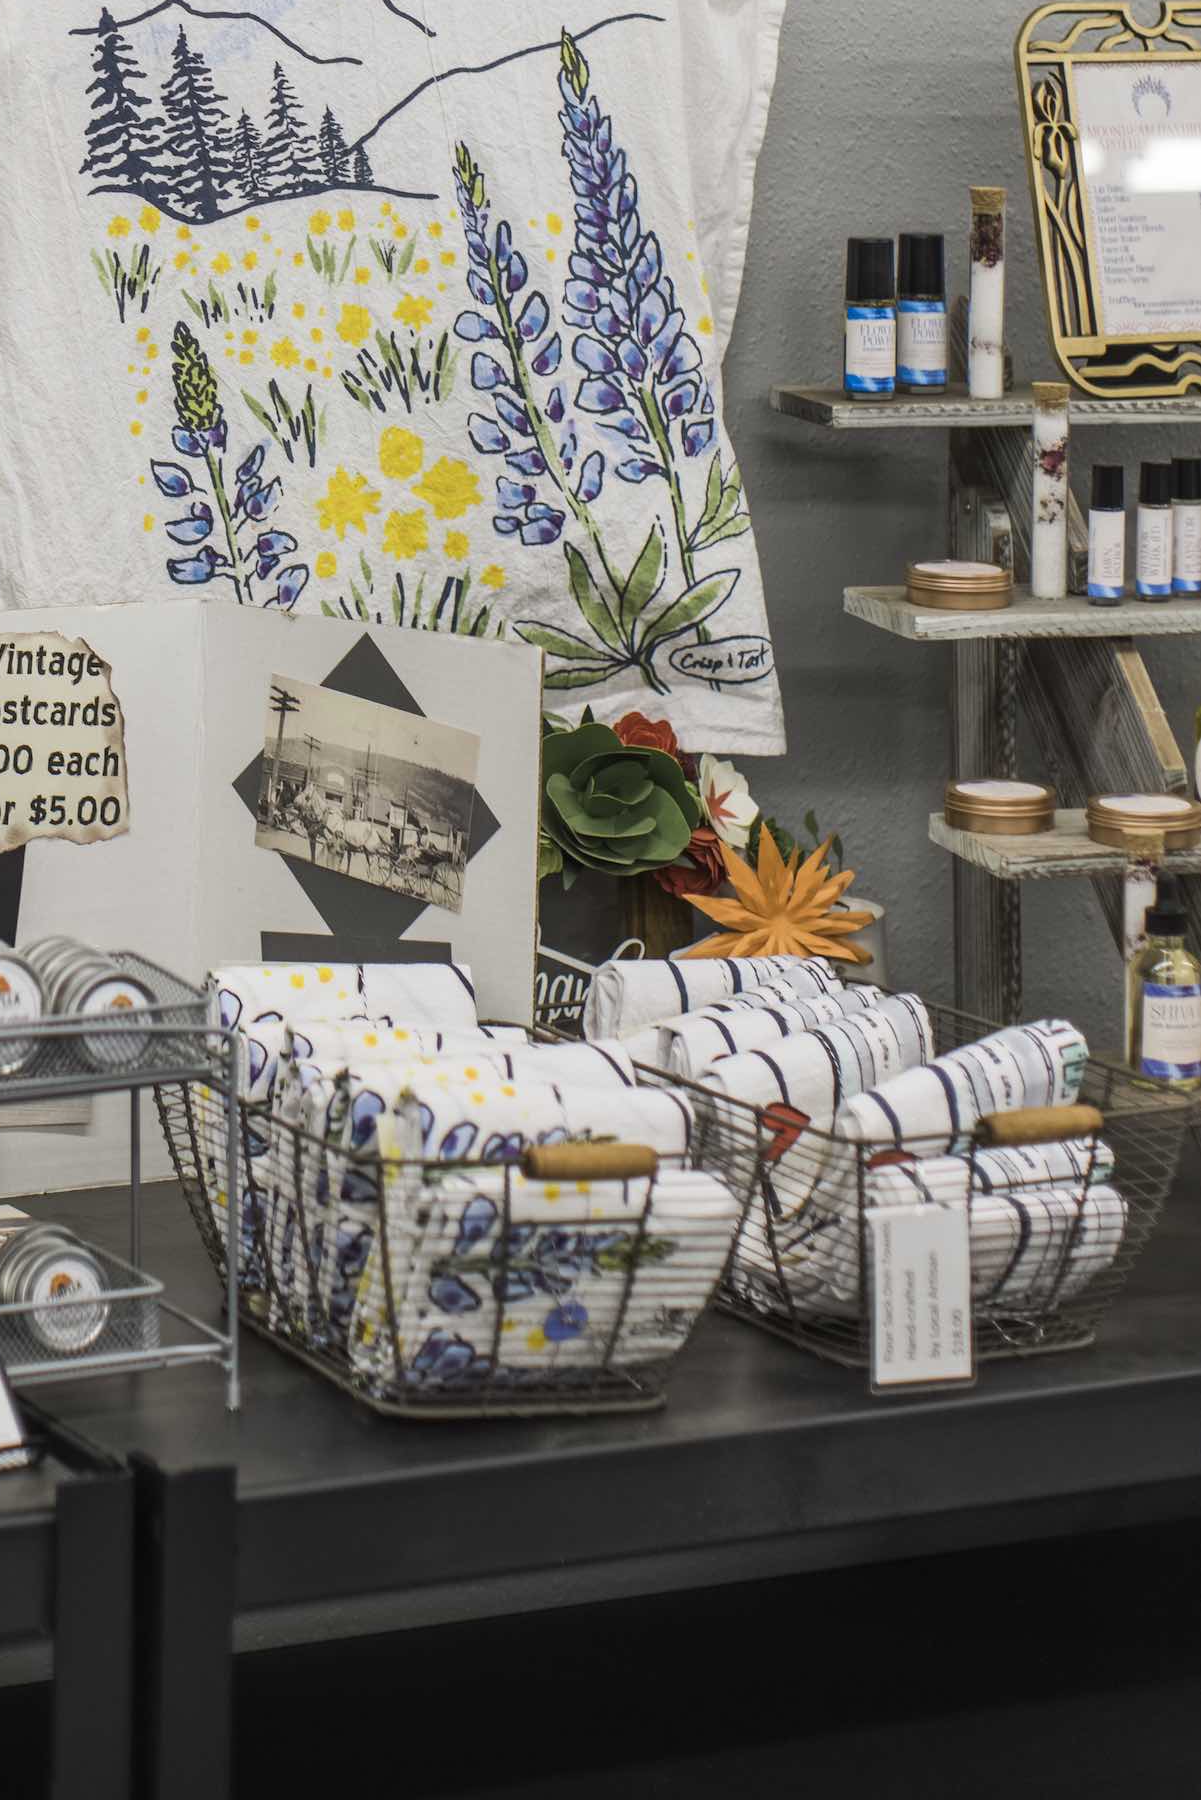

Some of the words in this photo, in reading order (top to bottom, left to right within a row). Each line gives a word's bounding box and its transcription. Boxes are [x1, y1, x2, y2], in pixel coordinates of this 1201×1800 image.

[47, 745, 119, 776] each
[29, 795, 121, 825] $5.00
[929, 1251, 939, 1299] Artisan
[929, 1303, 940, 1338] Local
[930, 1341, 941, 1360] by
